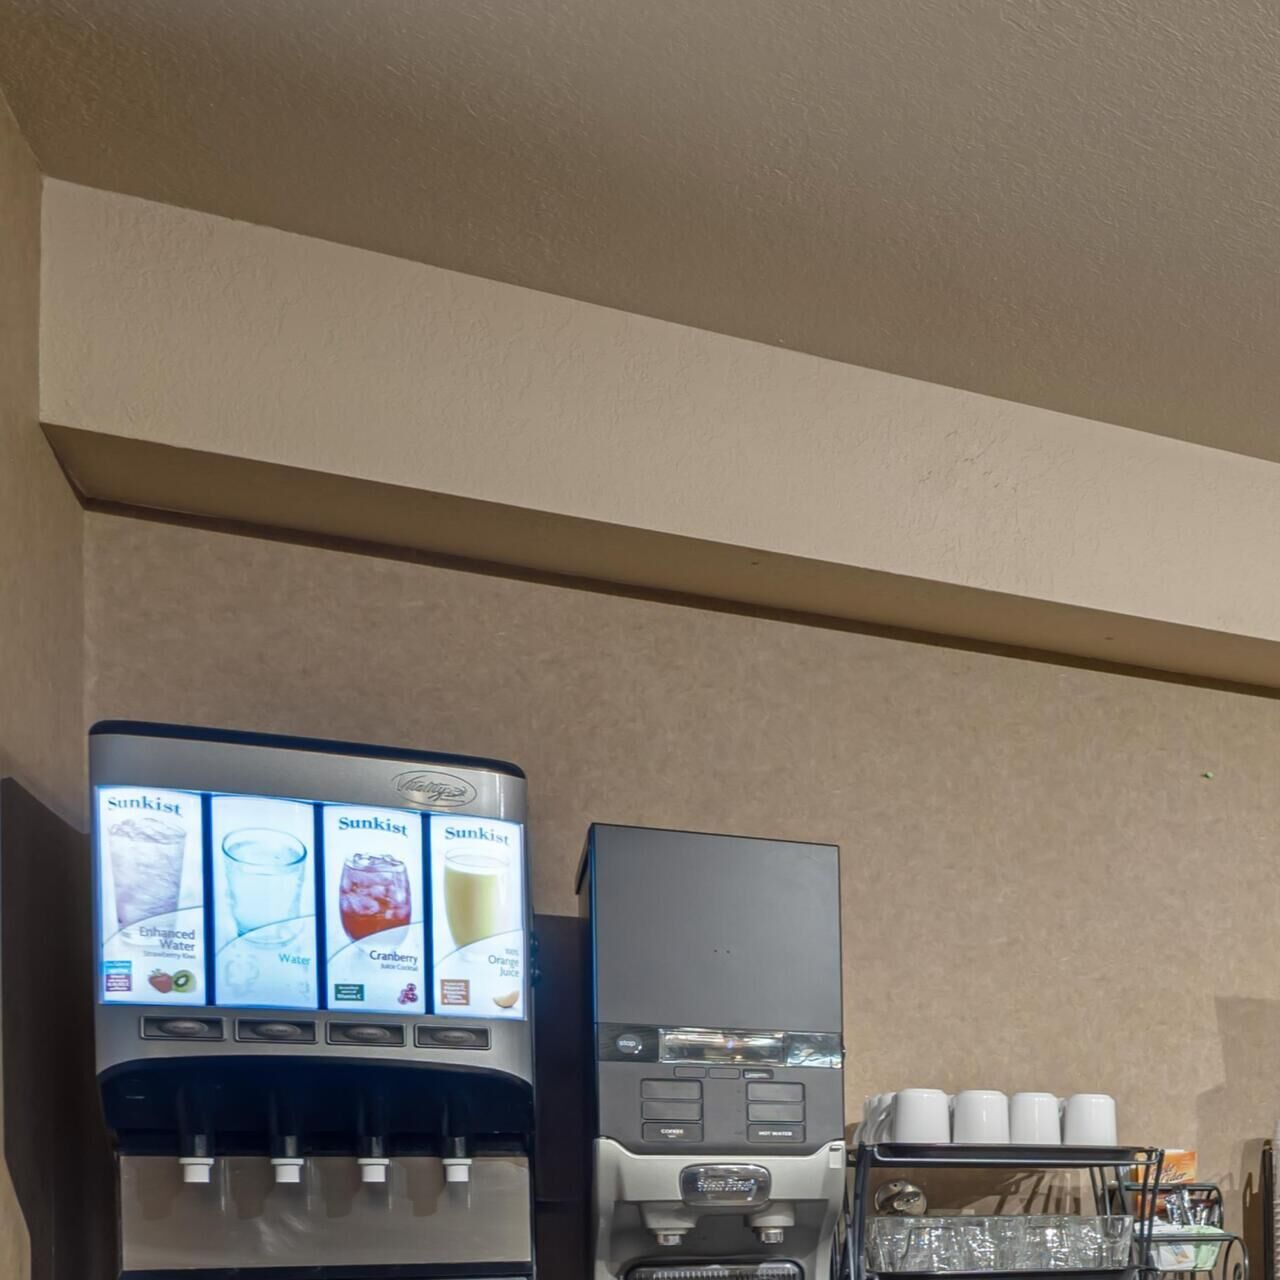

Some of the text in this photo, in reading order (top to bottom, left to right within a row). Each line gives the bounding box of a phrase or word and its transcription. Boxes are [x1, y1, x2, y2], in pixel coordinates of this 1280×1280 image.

[107, 795, 184, 818] Sunkist
[338, 816, 409, 838] Sunkist
[444, 826, 511, 847] Sunkist
[139, 926, 196, 940] Enhanced
[159, 939, 196, 952] Water
[278, 953, 311, 966] Water
[369, 950, 418, 964] Cranberry
[488, 954, 520, 968] Orange
[499, 966, 520, 977] Juice
